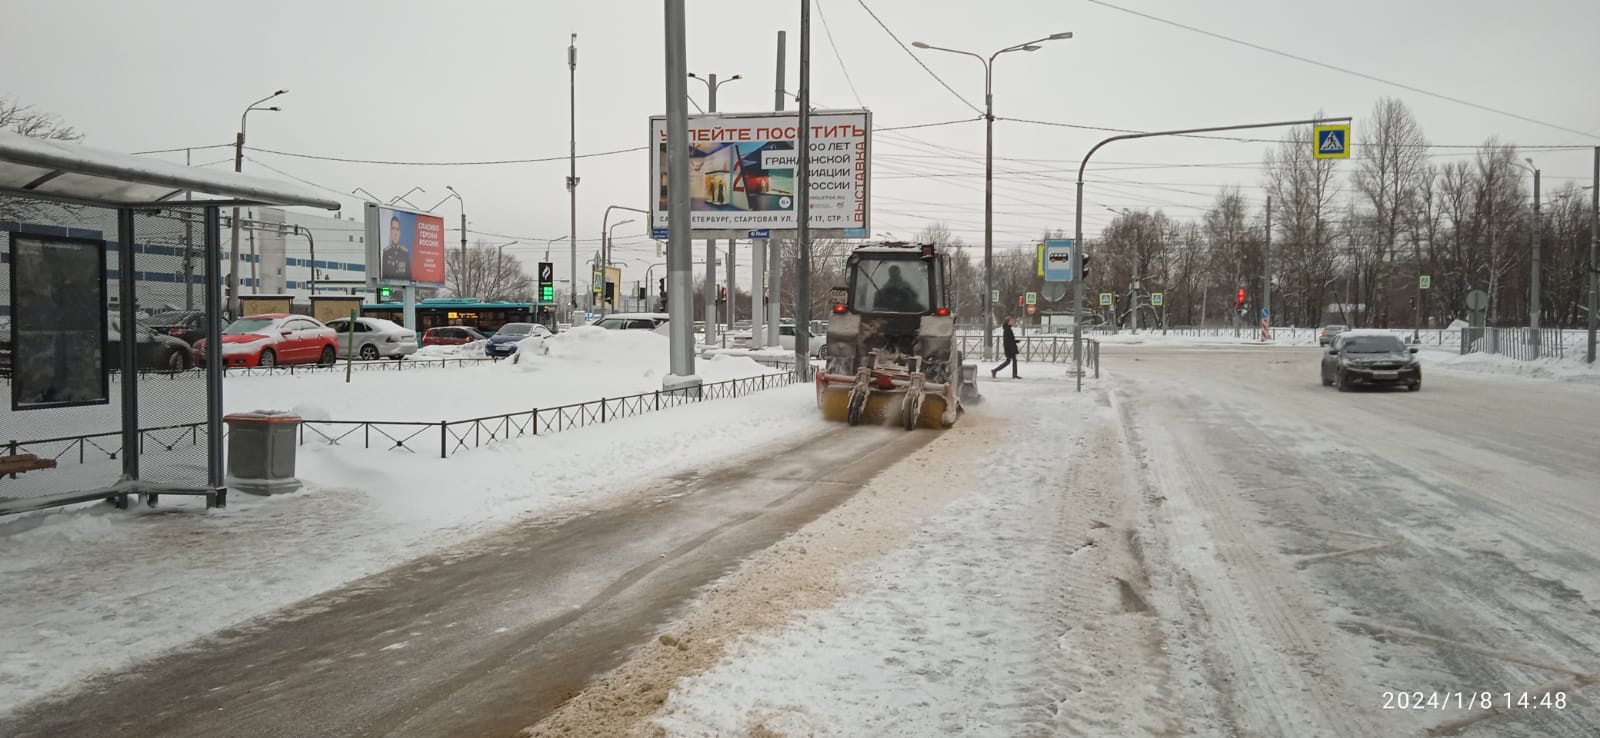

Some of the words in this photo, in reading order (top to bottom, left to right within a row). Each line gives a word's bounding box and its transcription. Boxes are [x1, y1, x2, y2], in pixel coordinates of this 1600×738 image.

[660, 126, 751, 141] УПЕЙТЕ
[757, 125, 865, 140] ПОСТИТЬ
[828, 142, 850, 151] ЛЕТ
[855, 141, 865, 222] ВЫСТАВКА
